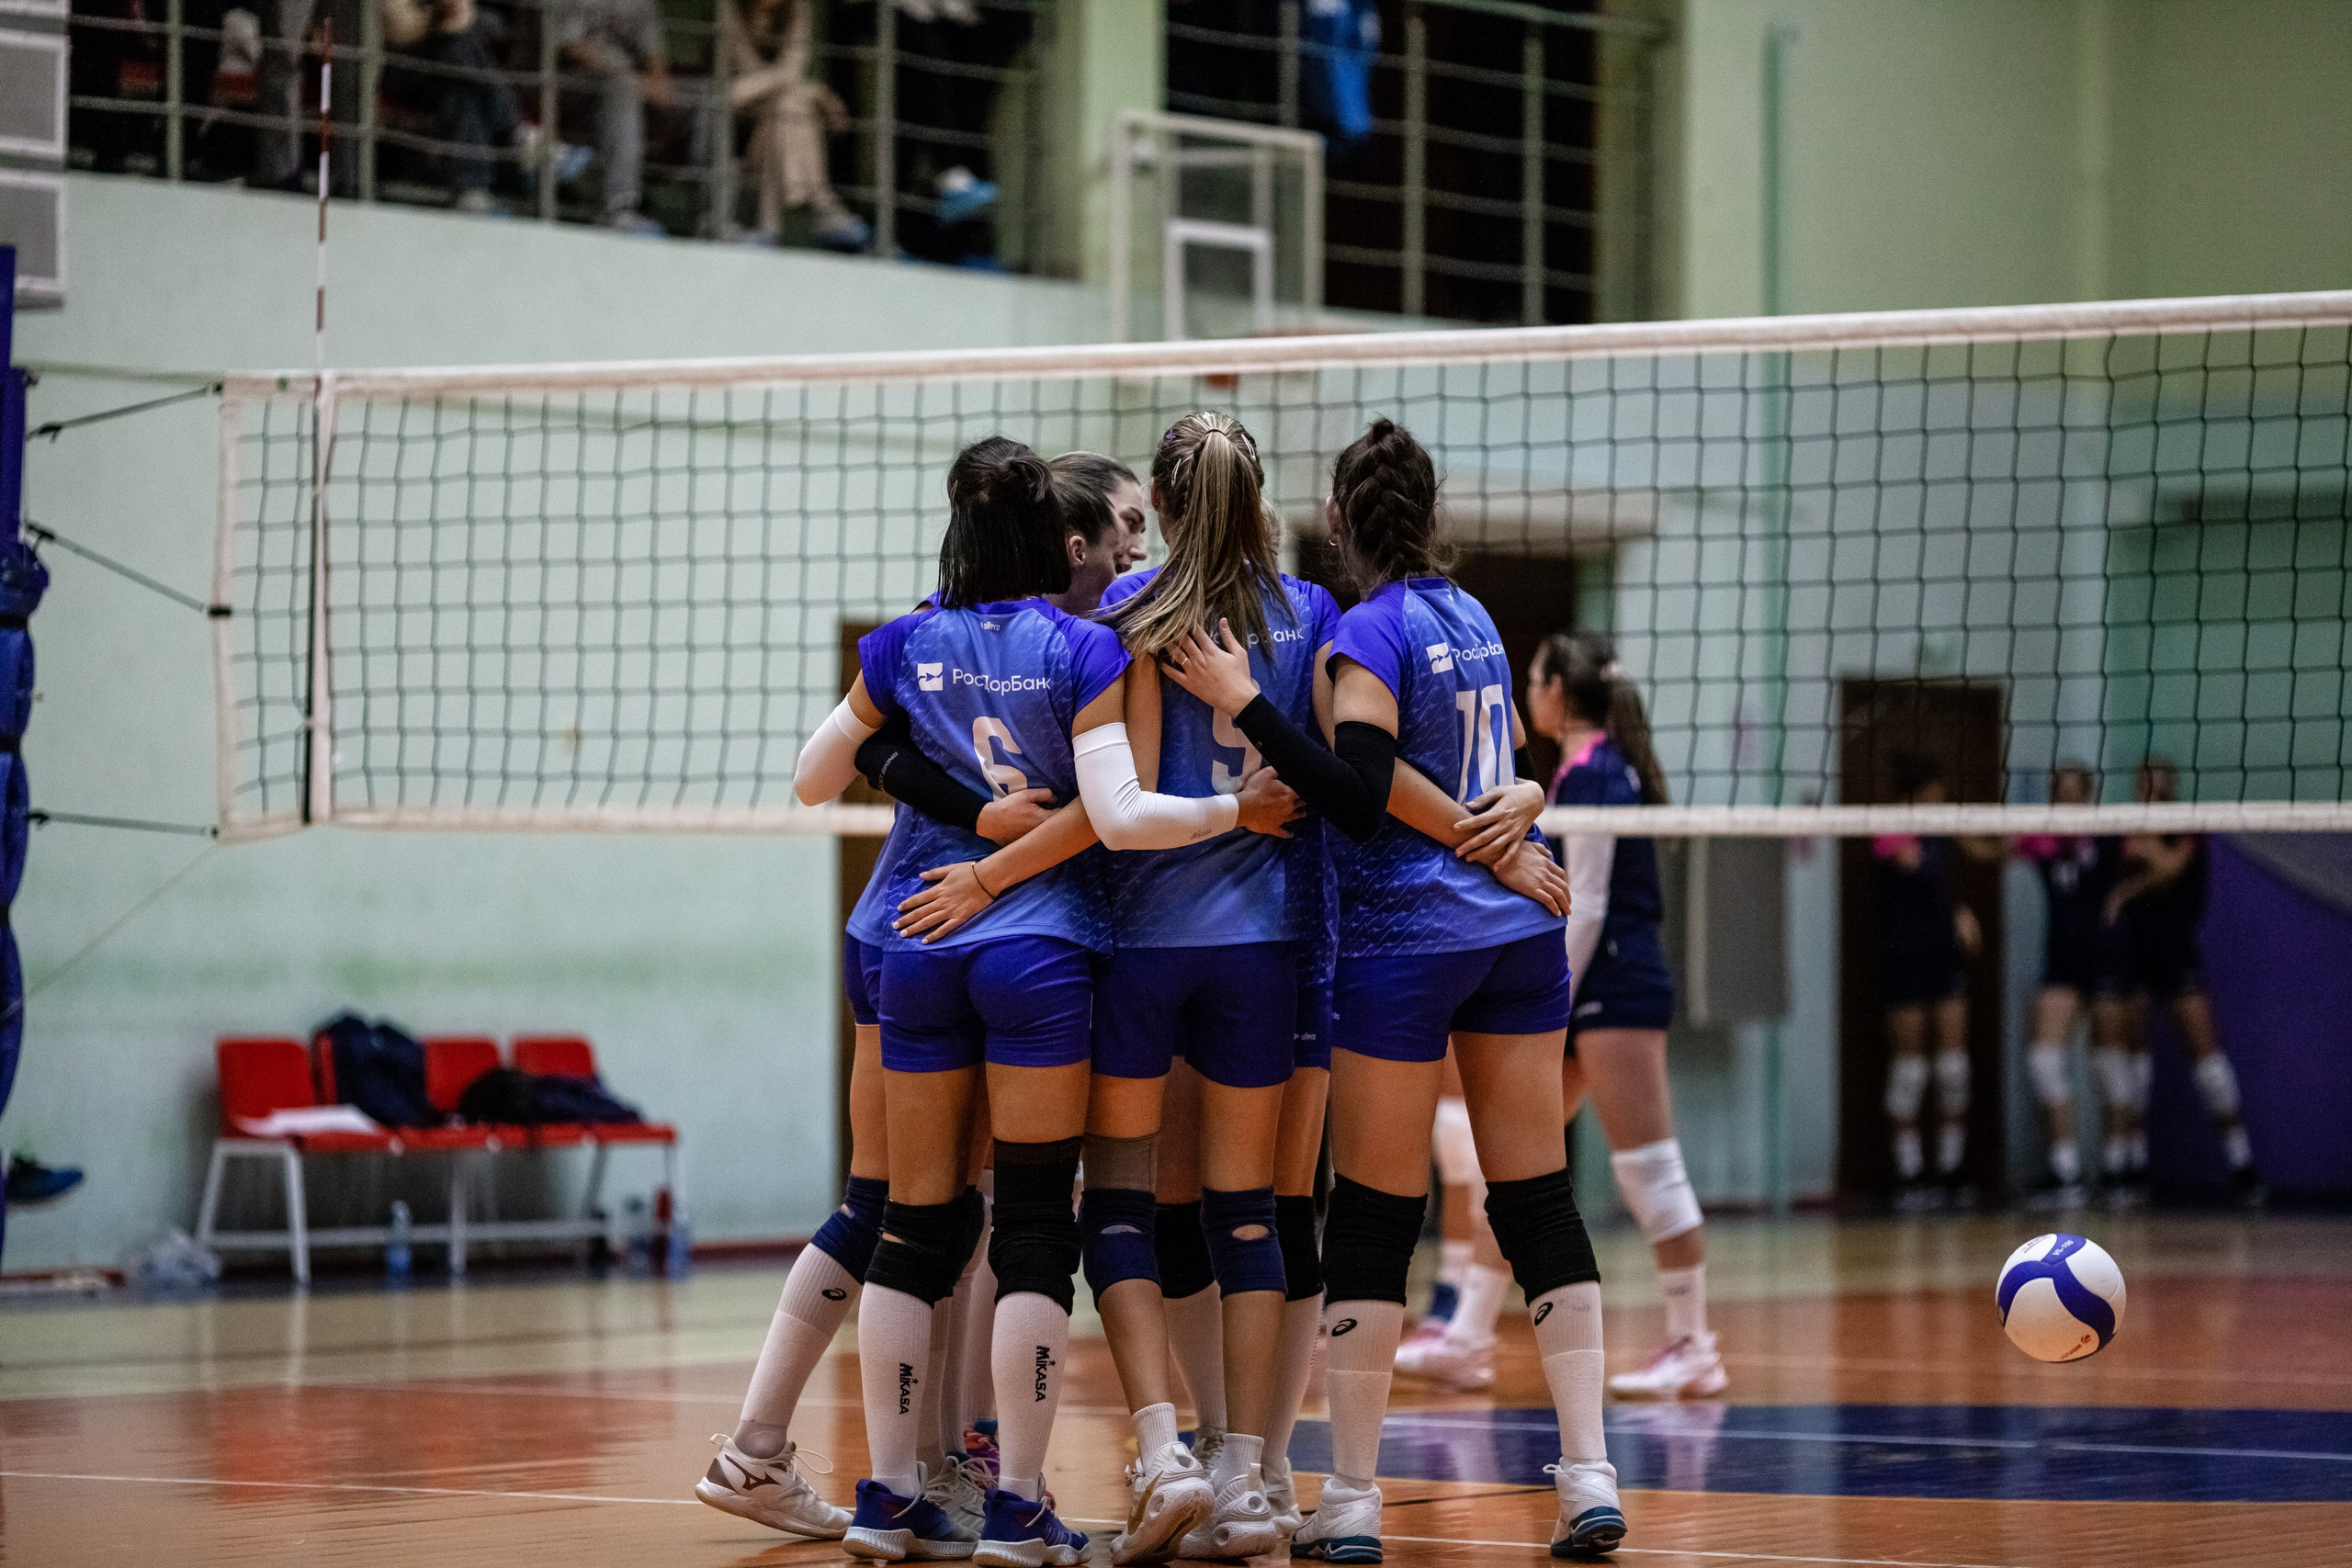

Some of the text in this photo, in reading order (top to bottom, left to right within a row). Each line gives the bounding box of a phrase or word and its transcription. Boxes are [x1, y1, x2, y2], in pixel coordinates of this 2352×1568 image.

[972, 716, 1028, 802] 6
[1456, 683, 1516, 806] 10
[899, 1362, 919, 1415] MIKASA
[1035, 1345, 1057, 1403] MIKASA
